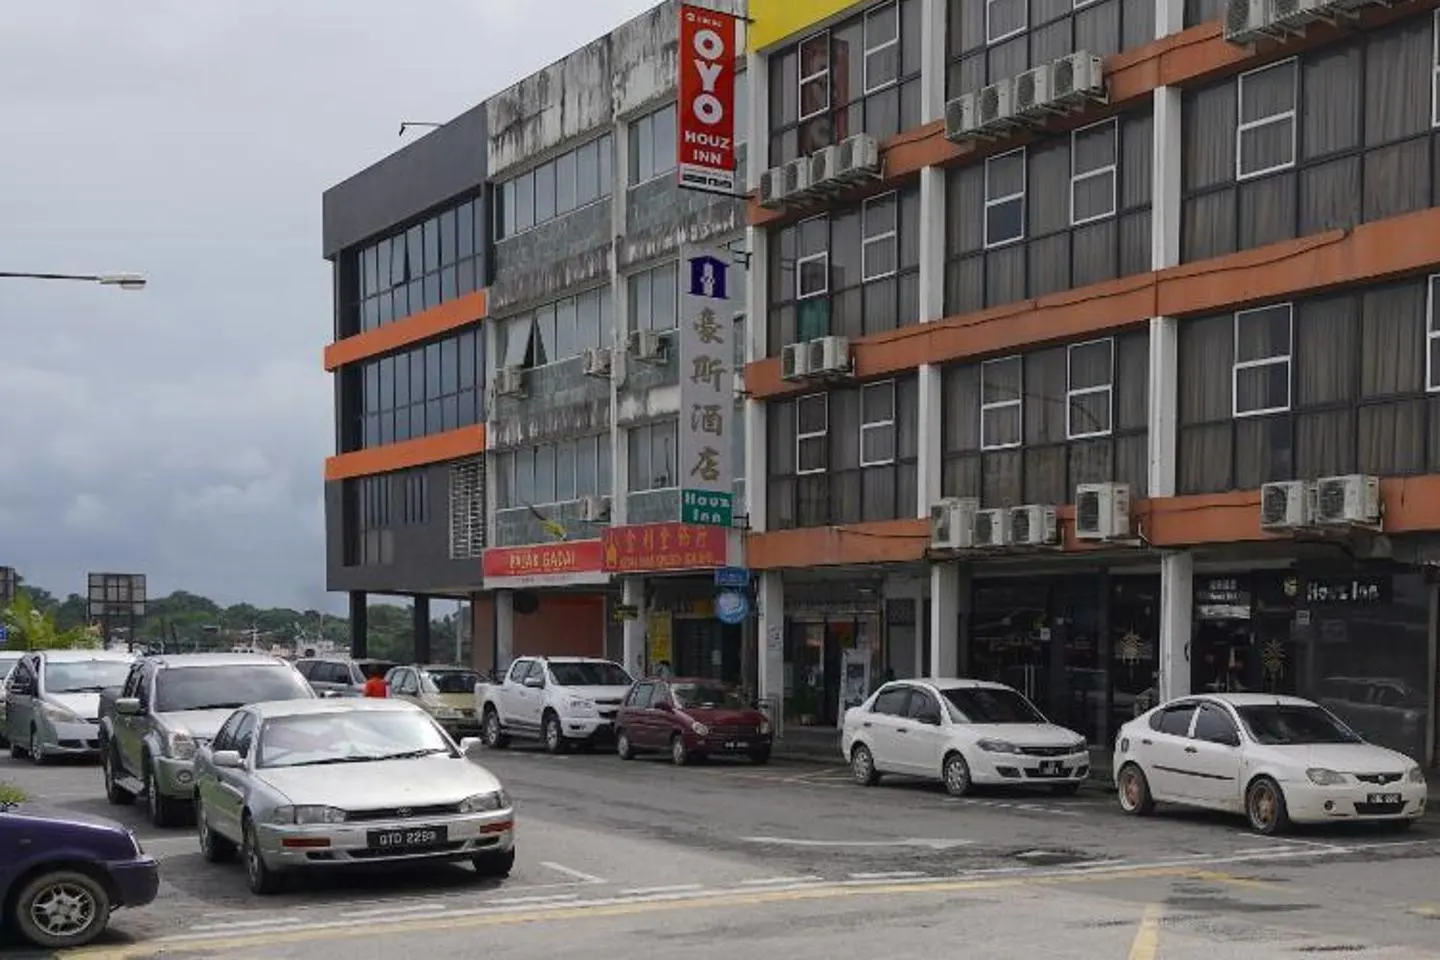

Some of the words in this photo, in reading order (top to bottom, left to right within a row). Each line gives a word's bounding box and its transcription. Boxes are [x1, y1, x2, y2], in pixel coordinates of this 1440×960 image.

[693, 29, 724, 125] OYO
[685, 130, 731, 150] HOUZ
[693, 149, 721, 165] INN
[690, 306, 727, 481] 豪斯酒店
[685, 492, 730, 509] Houz
[693, 508, 721, 524] Inn
